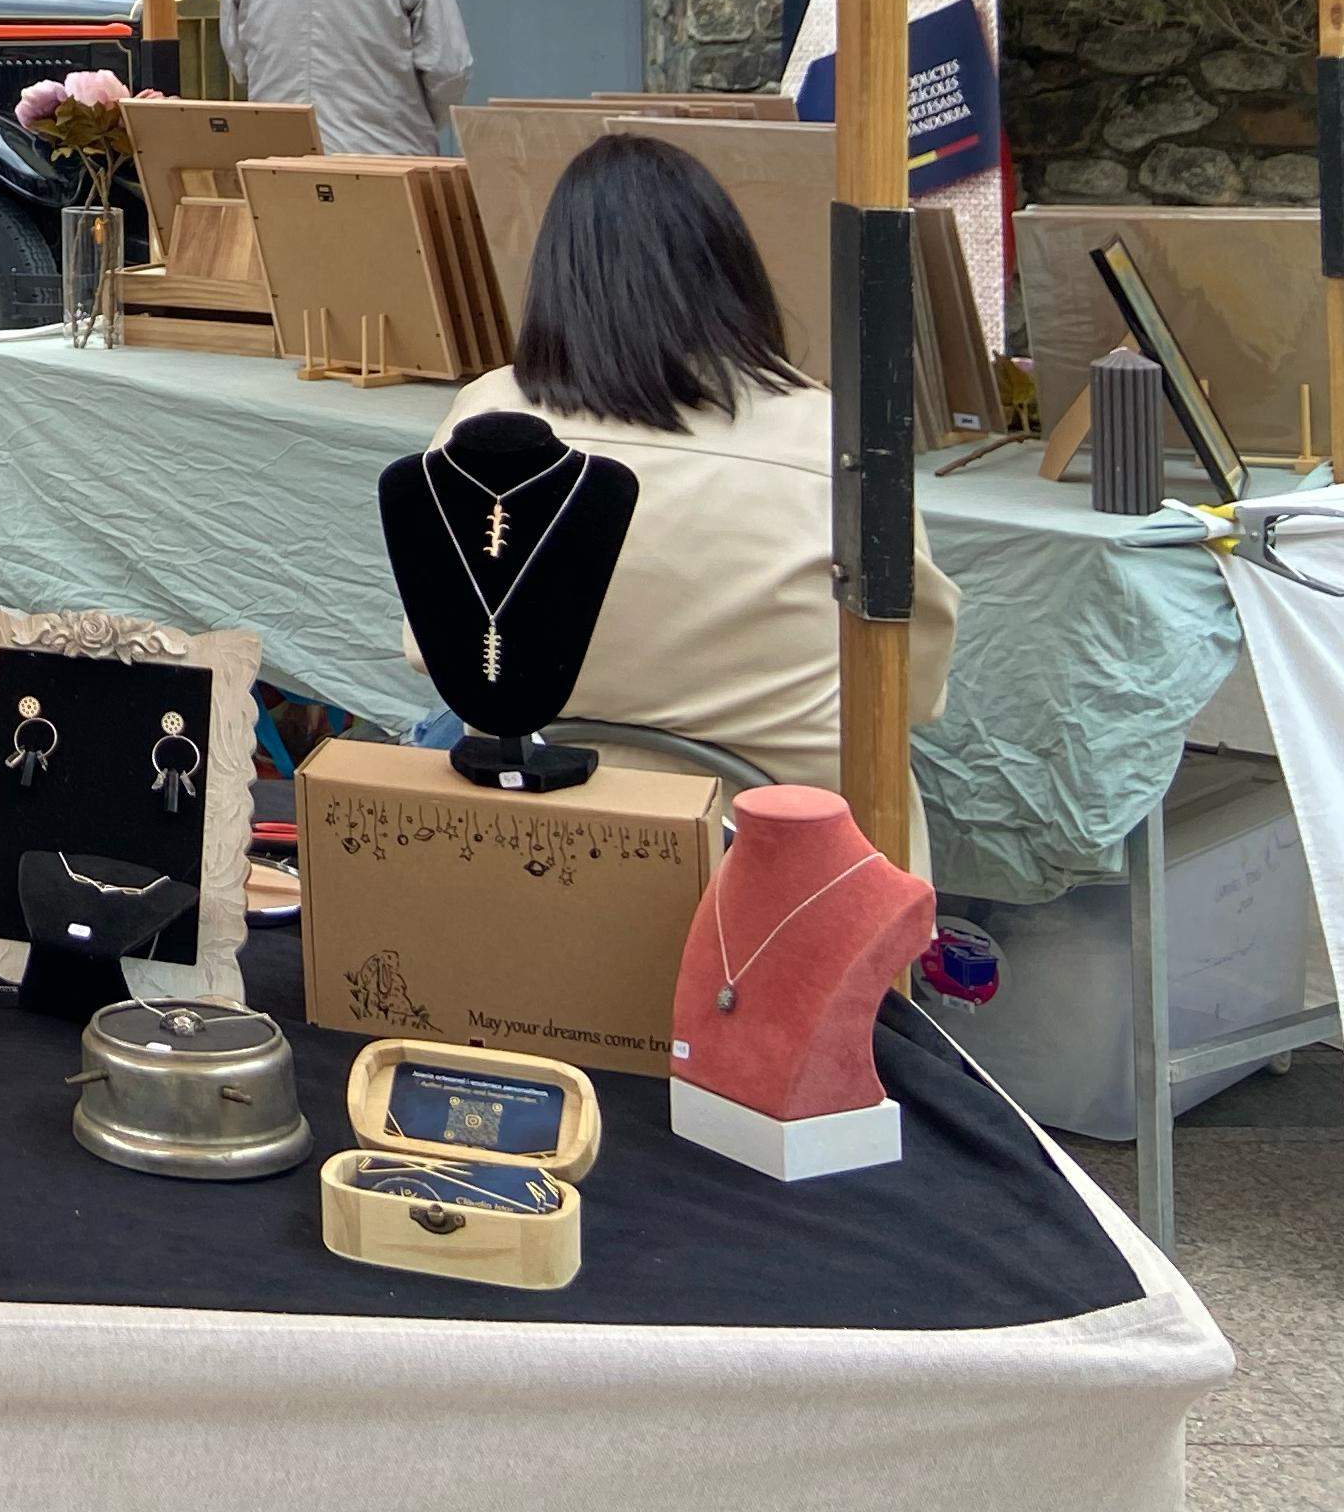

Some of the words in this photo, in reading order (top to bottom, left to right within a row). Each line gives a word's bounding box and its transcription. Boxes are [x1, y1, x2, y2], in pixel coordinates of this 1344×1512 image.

[467, 1009, 503, 1036] May
[503, 1021, 540, 1038] your
[543, 1018, 601, 1044] dreams
[603, 1032, 645, 1050] come
[649, 1035, 671, 1053] tru
